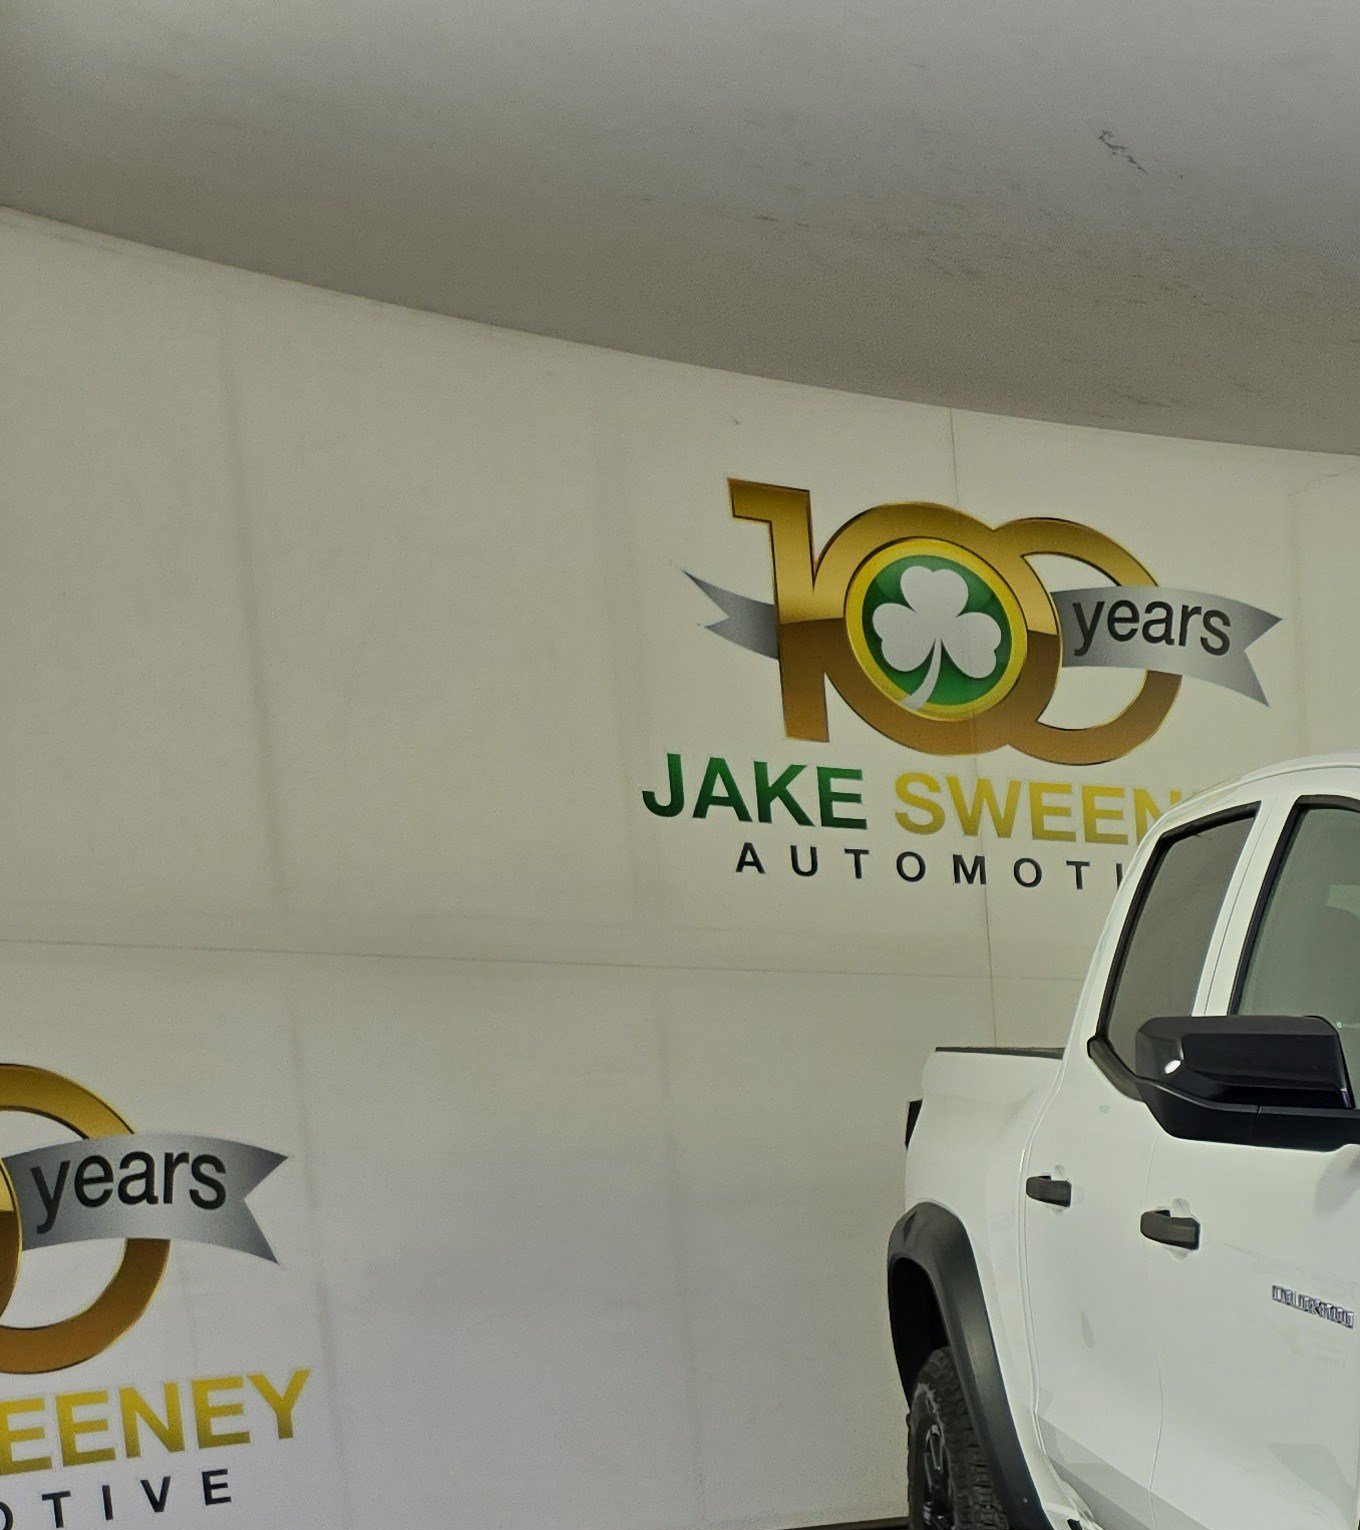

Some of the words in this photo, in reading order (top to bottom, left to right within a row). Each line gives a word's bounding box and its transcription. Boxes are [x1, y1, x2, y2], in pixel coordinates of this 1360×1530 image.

[1071, 597, 1232, 657] years
[641, 752, 868, 831] JAKE
[893, 772, 1183, 846] SWEEN
[29, 1148, 229, 1235] years
